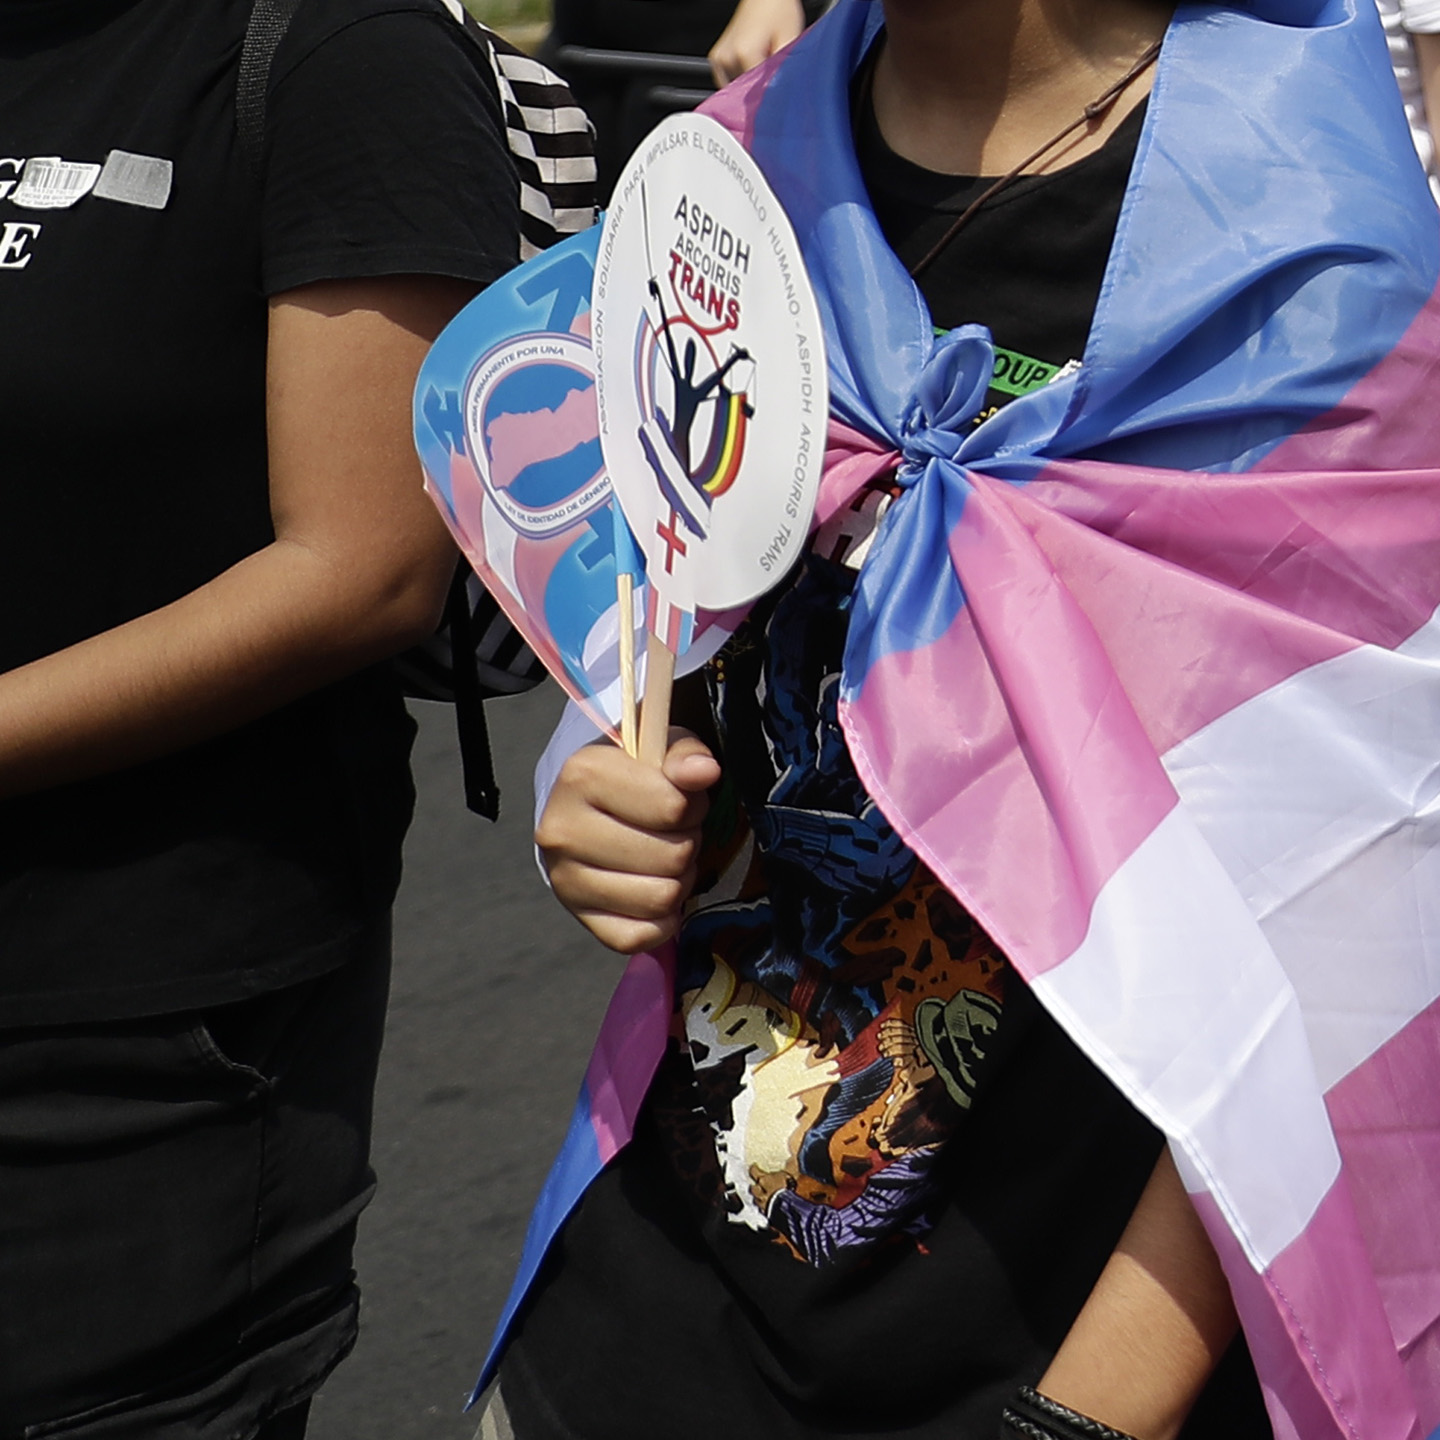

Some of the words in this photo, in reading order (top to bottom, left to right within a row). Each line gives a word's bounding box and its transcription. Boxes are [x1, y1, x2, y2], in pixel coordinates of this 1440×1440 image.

[646, 131, 689, 168] IMPULSAR
[693, 132, 704, 150] EL
[623, 163, 645, 203] PARA
[707, 138, 768, 222] DESARROLLO
[598, 204, 625, 299] SOLIDARIA
[674, 193, 751, 275] ASPIDH
[674, 232, 742, 297] ARCOIRIS
[668, 248, 741, 330] TRANS
[767, 226, 801, 316] HUMANO
[474, 353, 516, 404] PERMANENTE
[516, 346, 538, 359] POR
[540, 345, 564, 356] UNA
[796, 333, 813, 414] ASPIDH
[992, 354, 1049, 388] OUP
[526, 509, 566, 524] IDENTIDAD
[566, 502, 580, 515] DE
[579, 476, 611, 506] GÉNERO
[785, 423, 811, 519] ARCOIRIS
[759, 523, 792, 572] TRANS
